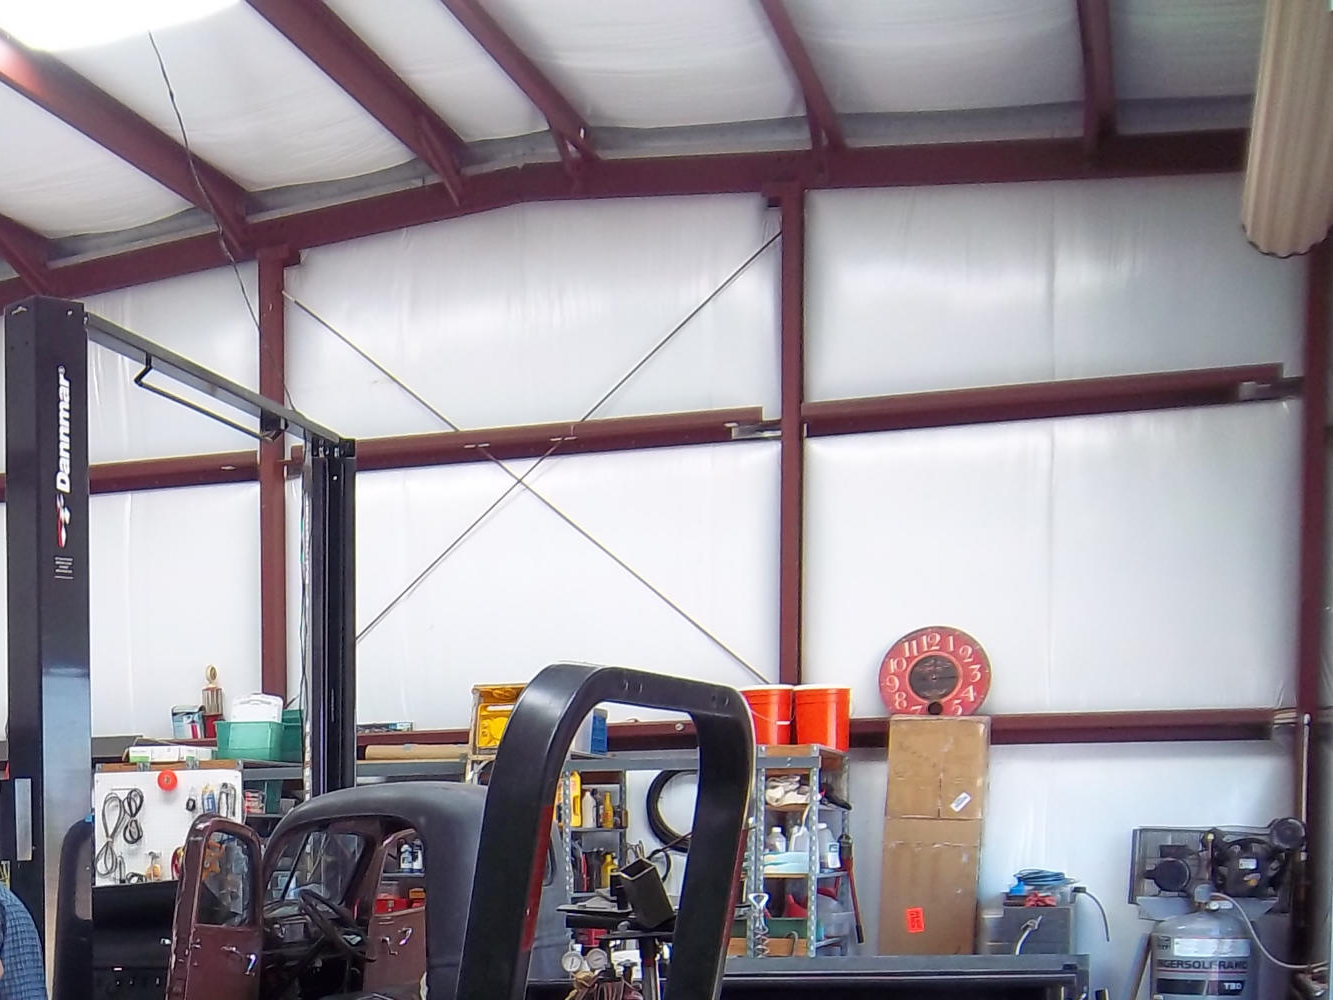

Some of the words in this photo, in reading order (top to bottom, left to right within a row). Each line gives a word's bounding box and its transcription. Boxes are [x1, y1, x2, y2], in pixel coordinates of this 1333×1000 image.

[56, 372, 71, 493] Dannmar
[904, 640, 920, 658] 11
[922, 632, 941, 651] 12
[948, 635, 955, 652] 1
[959, 645, 974, 662] 2
[889, 657, 907, 673] 10
[968, 664, 982, 683] 3
[886, 674, 900, 693] 9
[894, 691, 907, 710] 8
[961, 684, 976, 702] 4
[952, 699, 963, 716] 5
